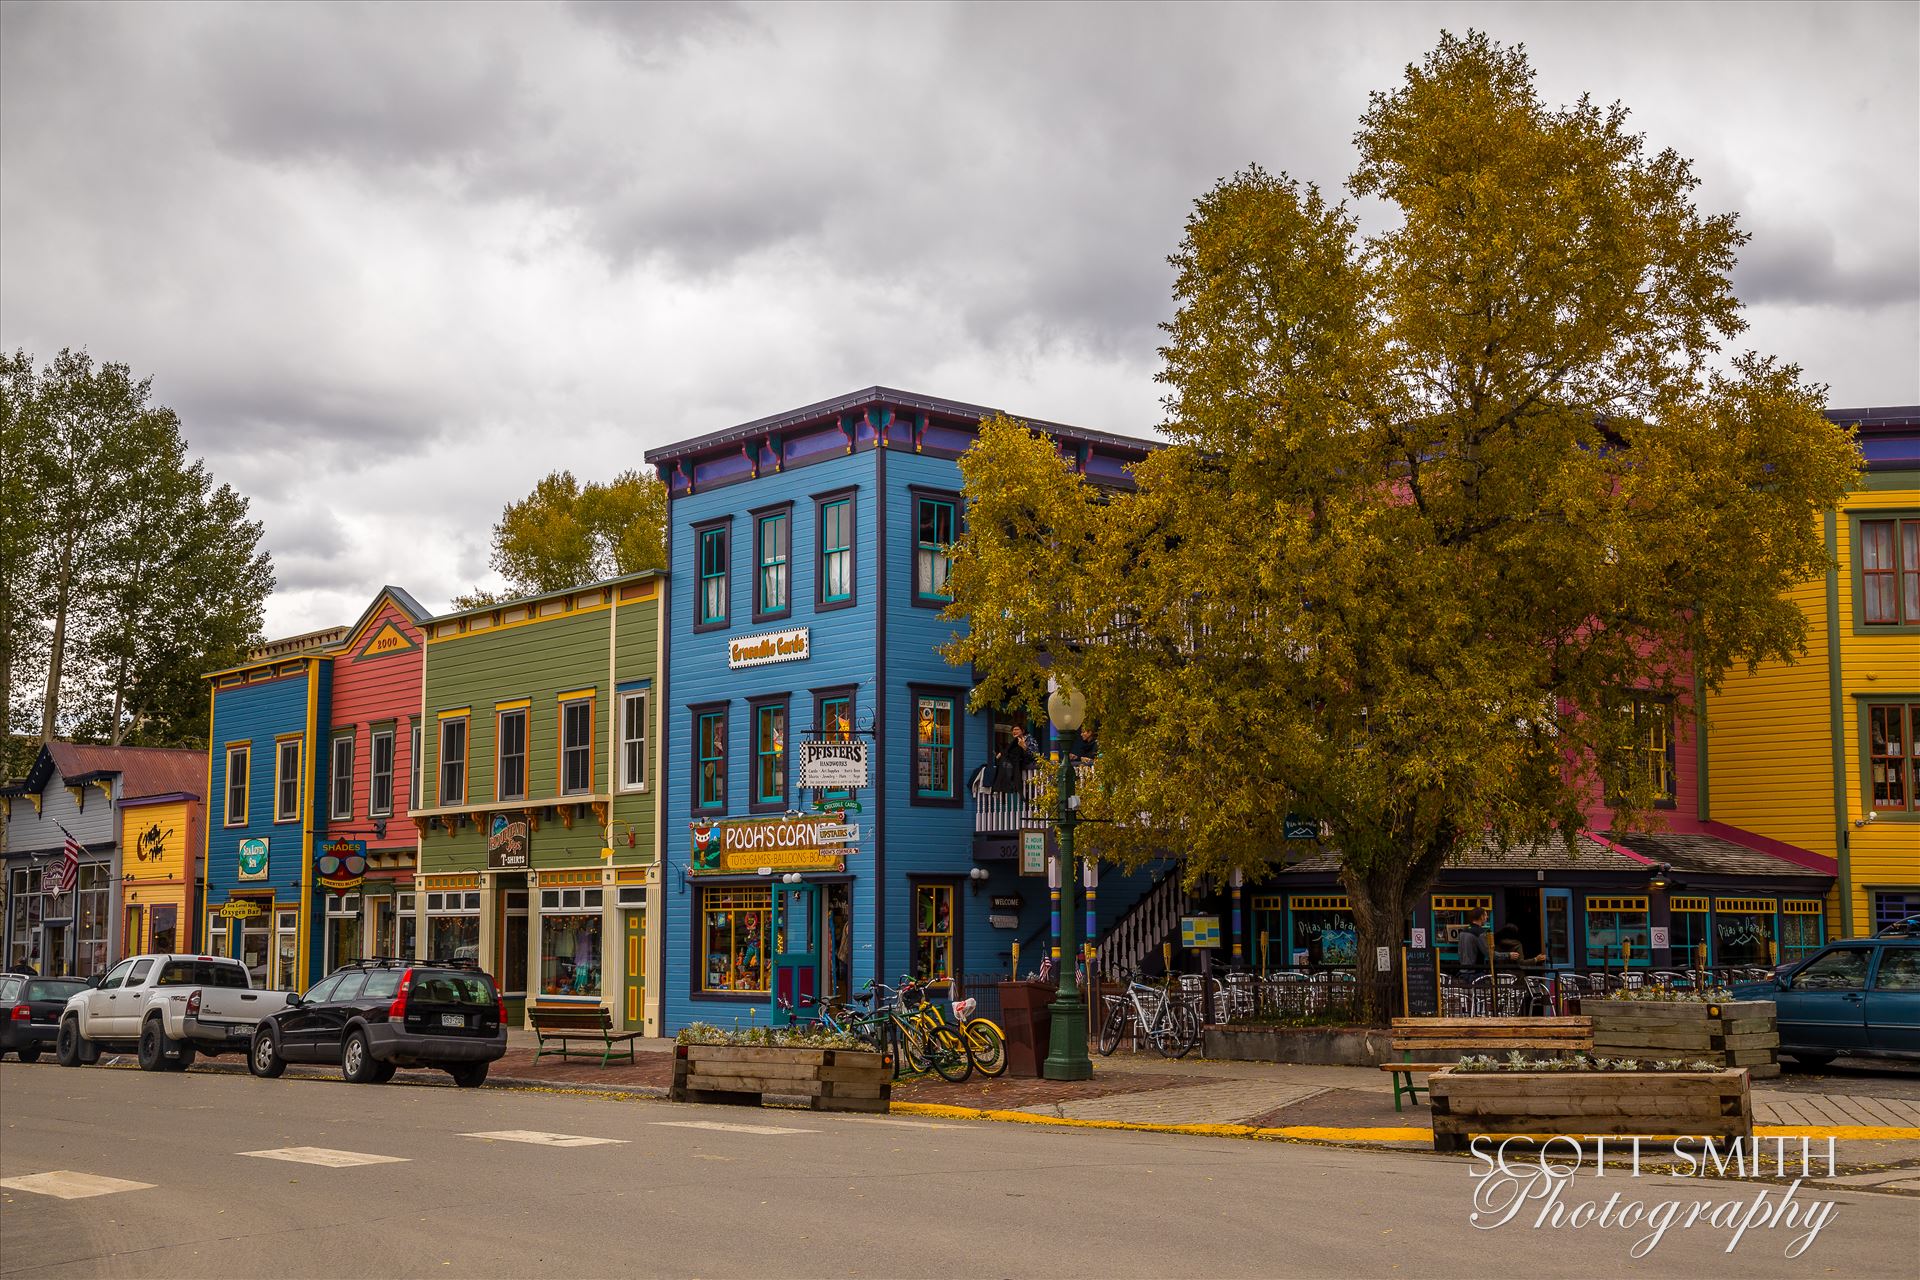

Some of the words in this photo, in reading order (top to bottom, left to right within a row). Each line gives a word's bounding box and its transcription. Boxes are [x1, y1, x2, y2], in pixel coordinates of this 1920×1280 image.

[377, 636, 398, 649] 2000
[777, 633, 805, 656] Cards
[807, 745, 862, 764] PFISTERS
[824, 801, 844, 809] CROCODILE
[844, 801, 857, 809] CARDS
[726, 825, 775, 849] POOH'S
[777, 822, 837, 846] CORN
[820, 830, 848, 839] UPSTAIRS
[1000, 845, 1018, 857] 302
[501, 854, 525, 866] T-SHIRTS
[994, 898, 1019, 906] WELCOME
[222, 909, 246, 917] Oxygen
[1298, 921, 1320, 937] Pitas
[1323, 919, 1331, 931] in
[1718, 924, 1735, 940] Pitas
[1746, 917, 1771, 937] Paradise
